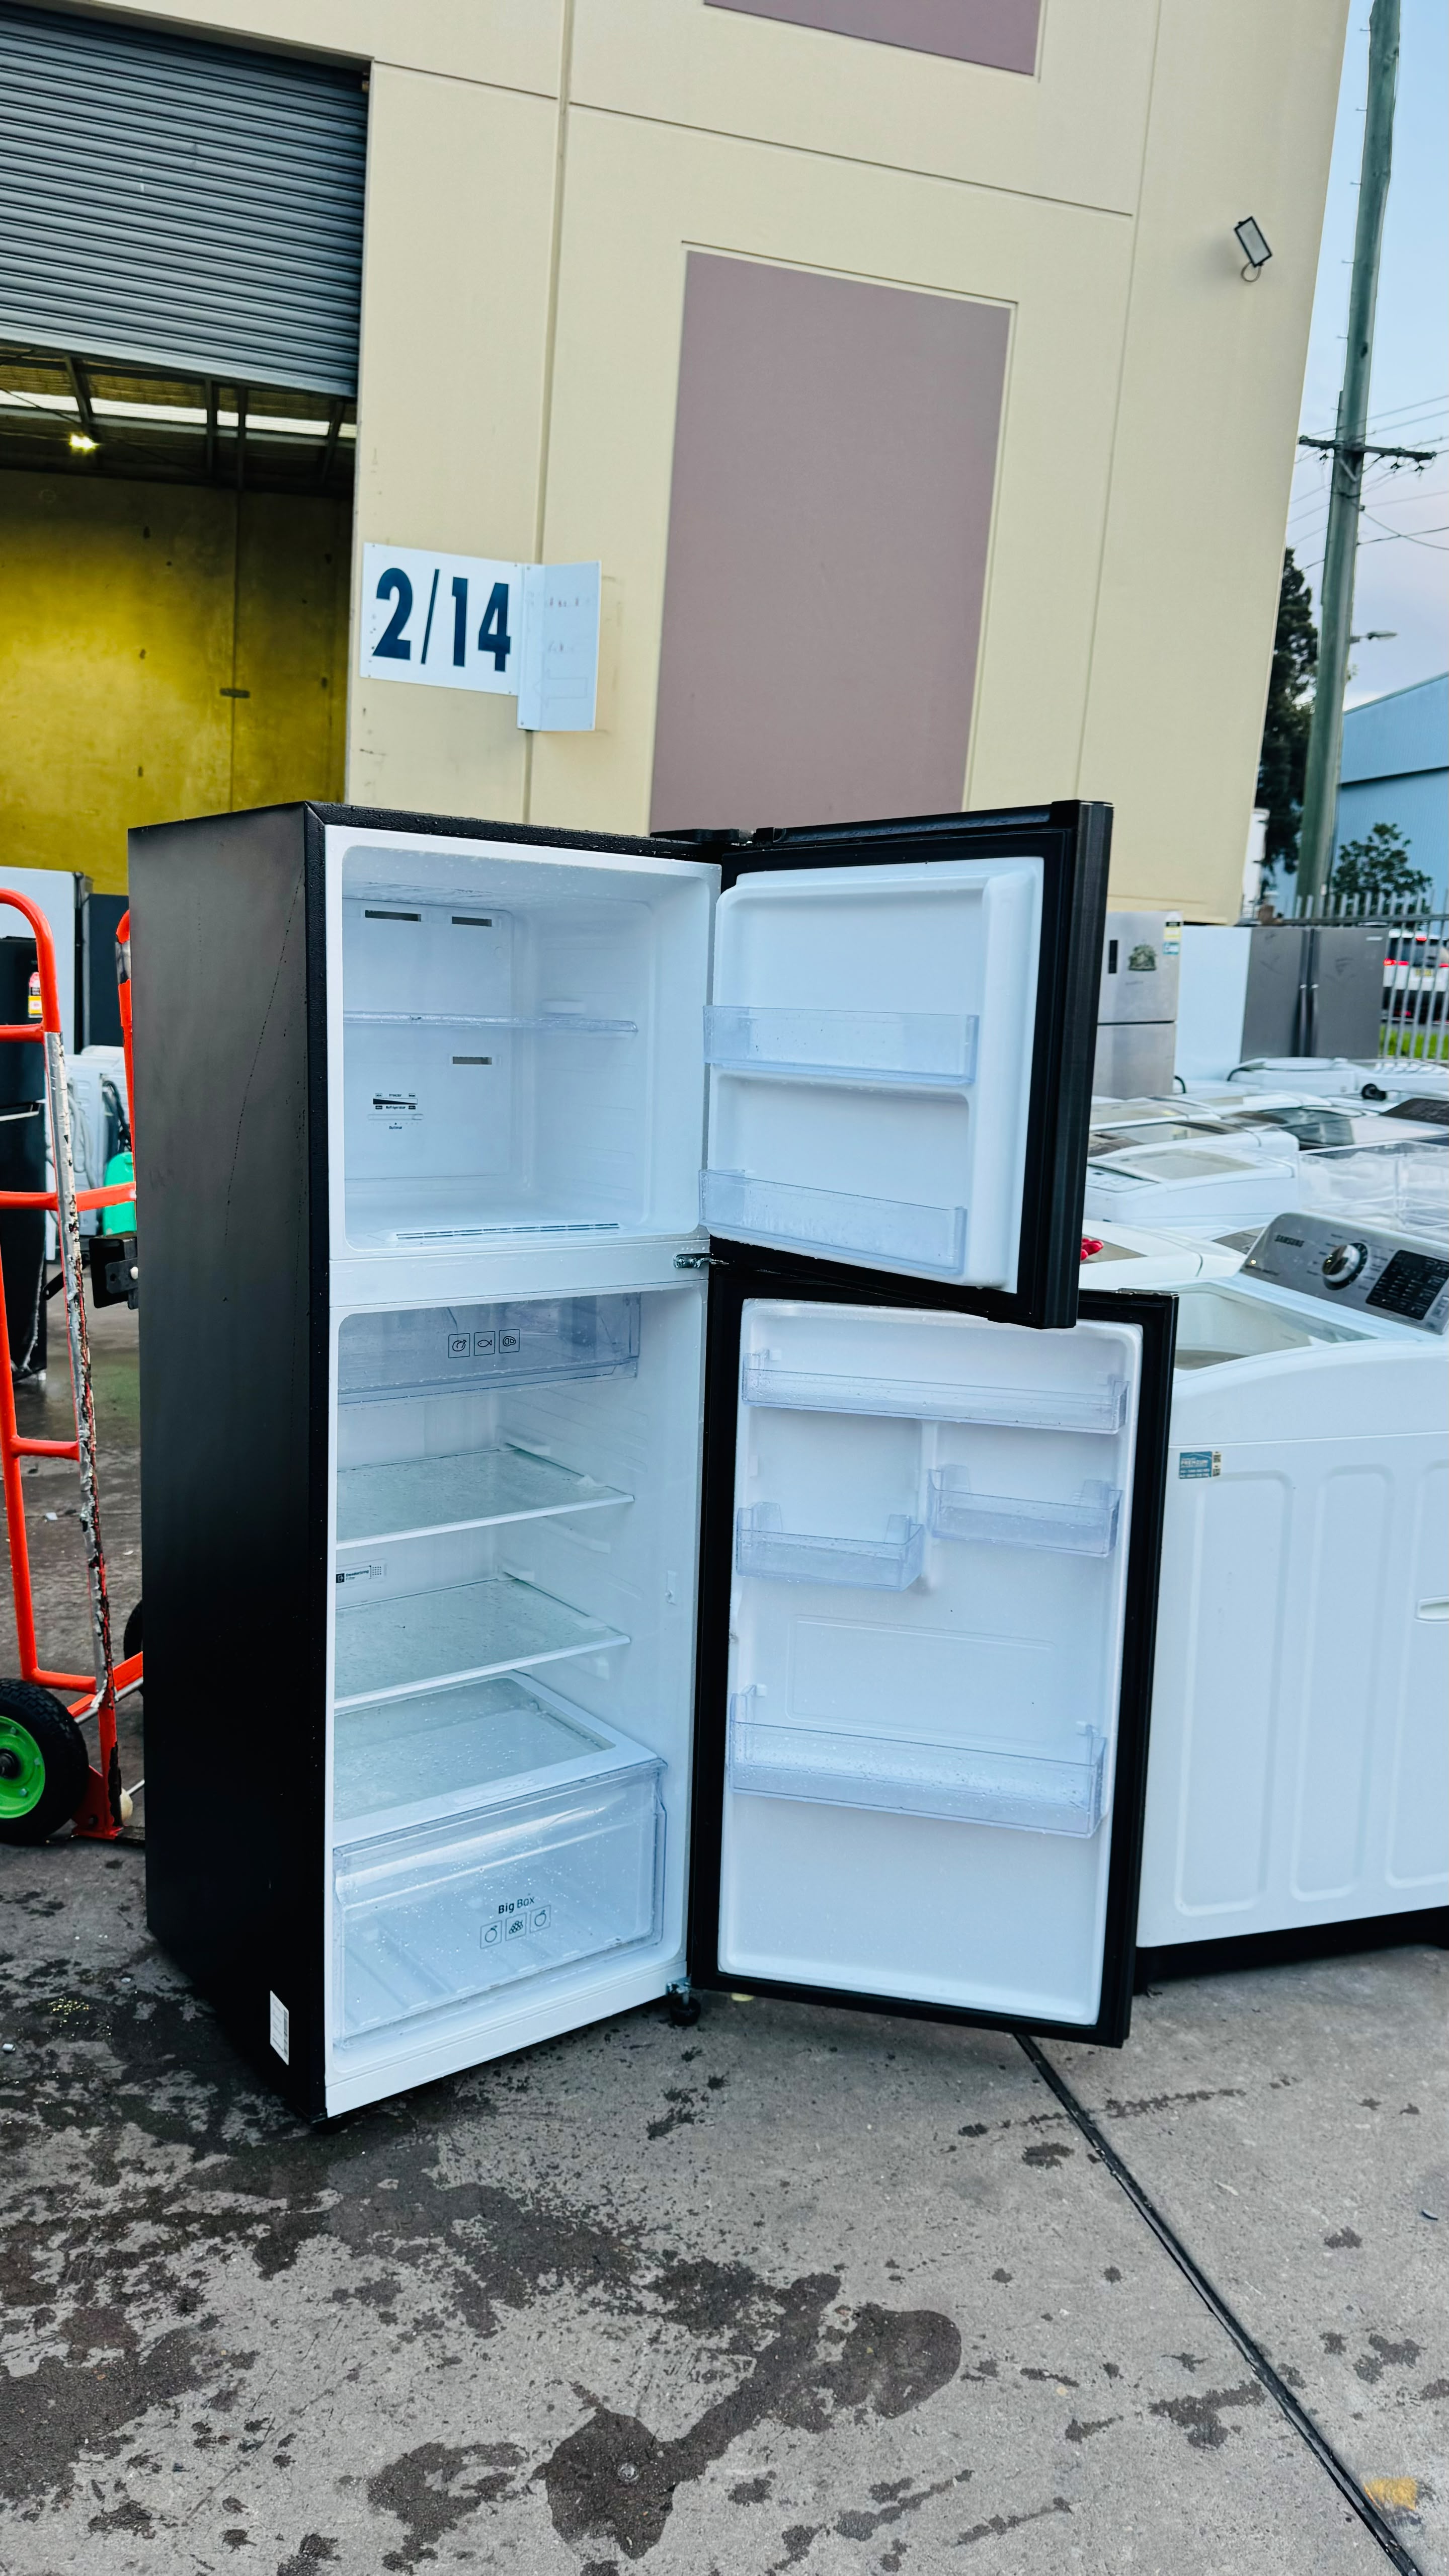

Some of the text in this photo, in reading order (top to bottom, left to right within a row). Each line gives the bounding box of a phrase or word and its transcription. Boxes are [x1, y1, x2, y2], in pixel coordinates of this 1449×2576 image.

[372, 568, 511, 672] 2/14
[1274, 1234, 1305, 1248] SAMSUNG
[498, 1897, 535, 1914] Big Box
